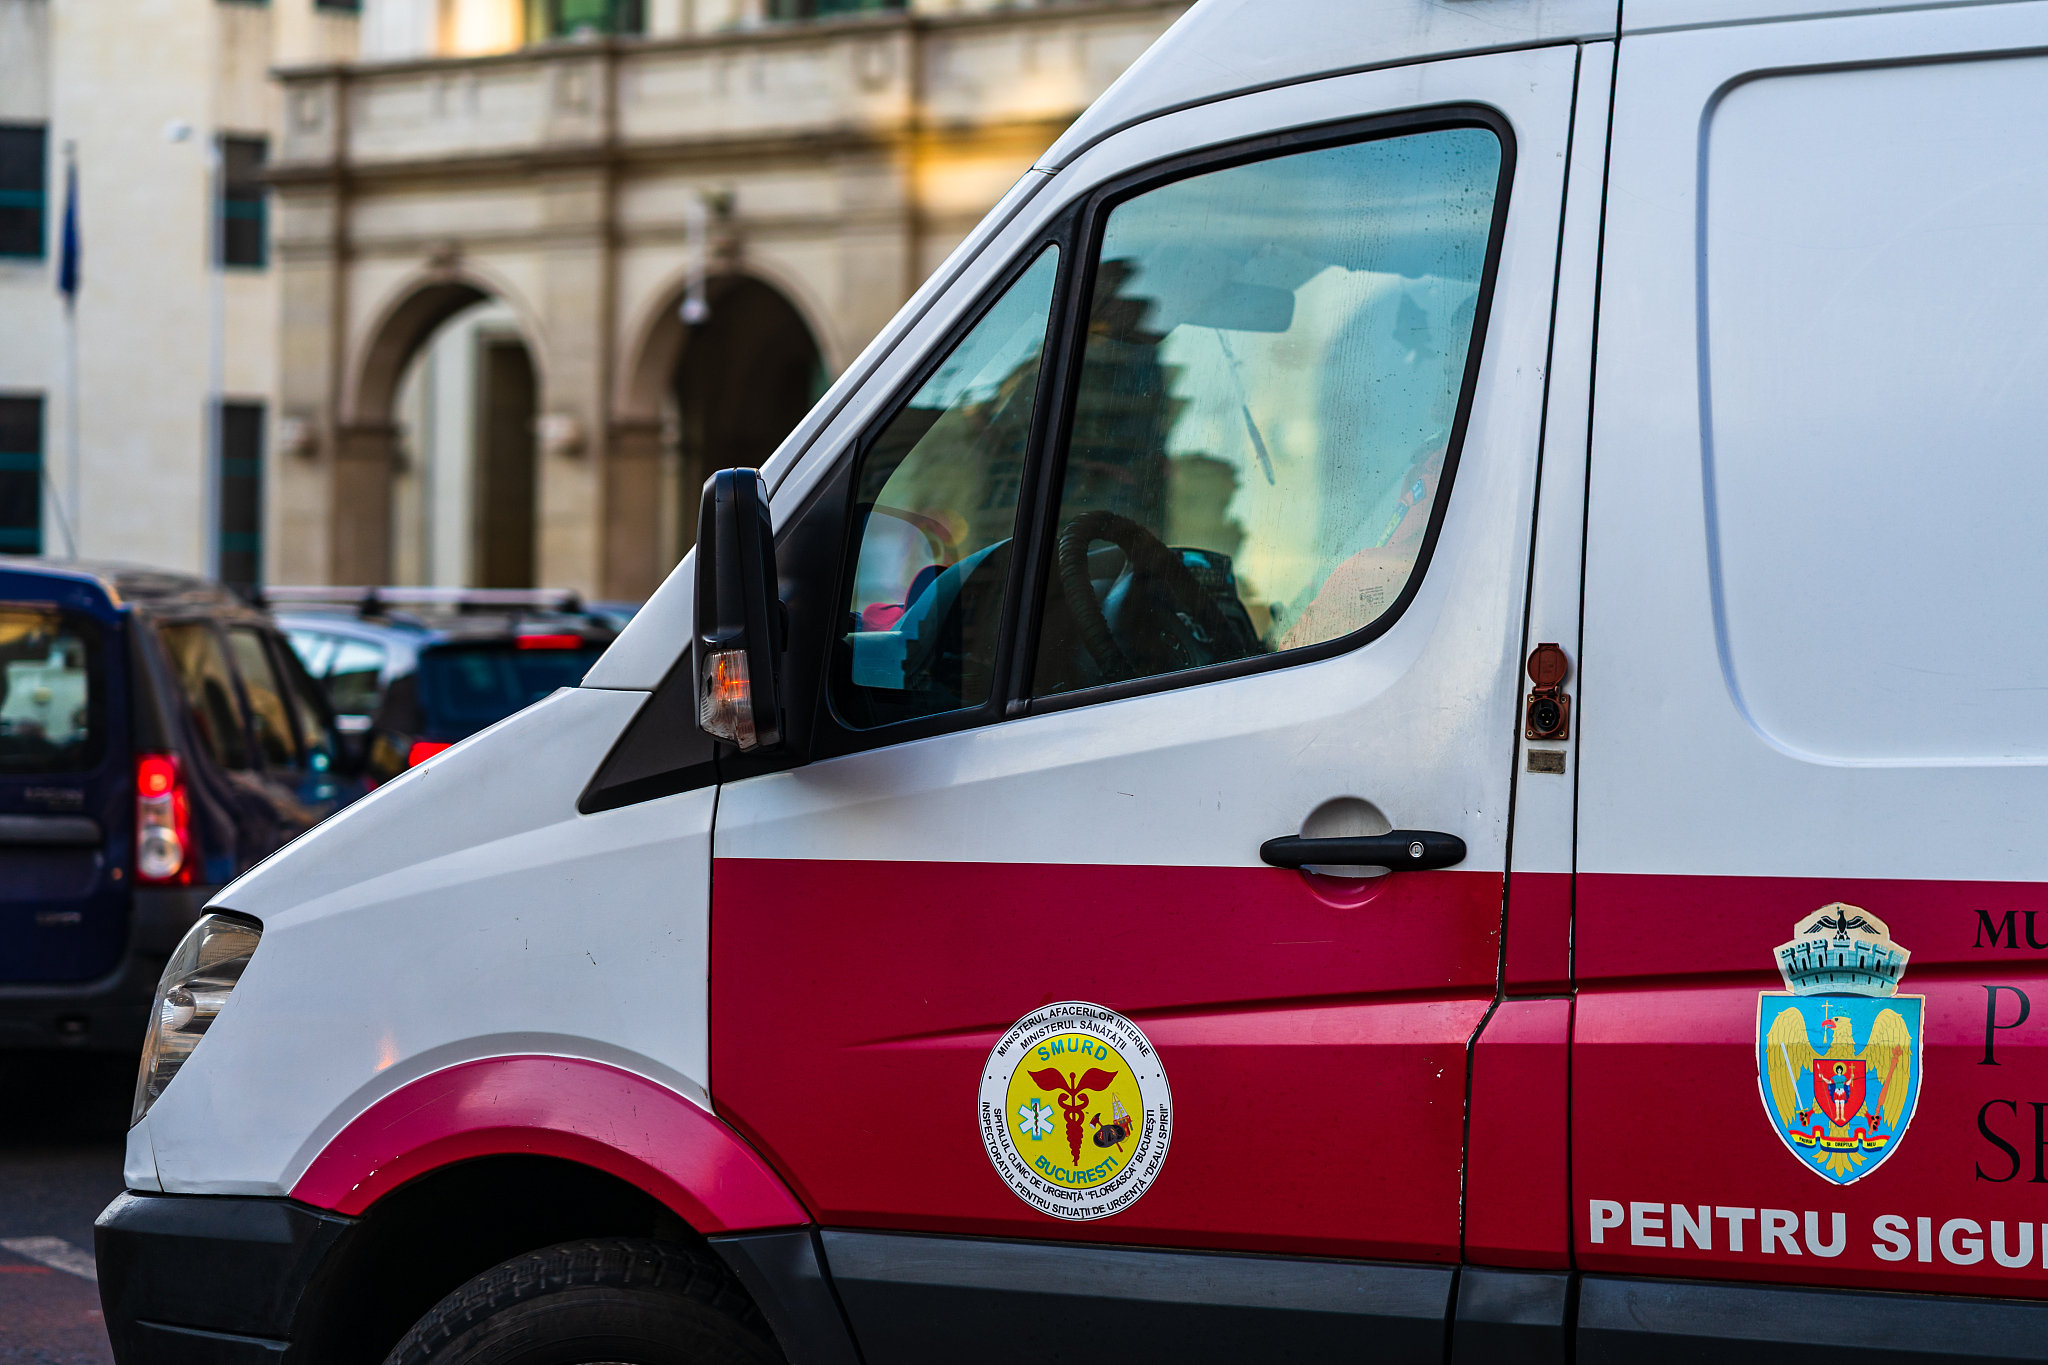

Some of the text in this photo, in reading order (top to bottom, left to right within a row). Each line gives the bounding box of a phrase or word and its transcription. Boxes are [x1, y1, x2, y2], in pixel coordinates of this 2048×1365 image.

[997, 1006, 1151, 1058] MINISTERUL AFACERILOR INTERNE
[1020, 1020, 1078, 1050] MINISTERUL
[1037, 1037, 1108, 1061] SMURD
[1976, 984, 2031, 1067] P
[981, 1101, 1016, 1185] INSPECTORATUL
[1014, 1181, 1051, 1209] PENTRU
[1091, 1204, 1107, 1215] DE
[993, 1108, 1011, 1154] SPITALUL
[1007, 1152, 1031, 1179] CLINIC
[1029, 1176, 1043, 1190] DE
[1034, 1154, 1119, 1184] BUCURESTI
[1589, 1199, 2048, 1270] PENTRU SIGU
